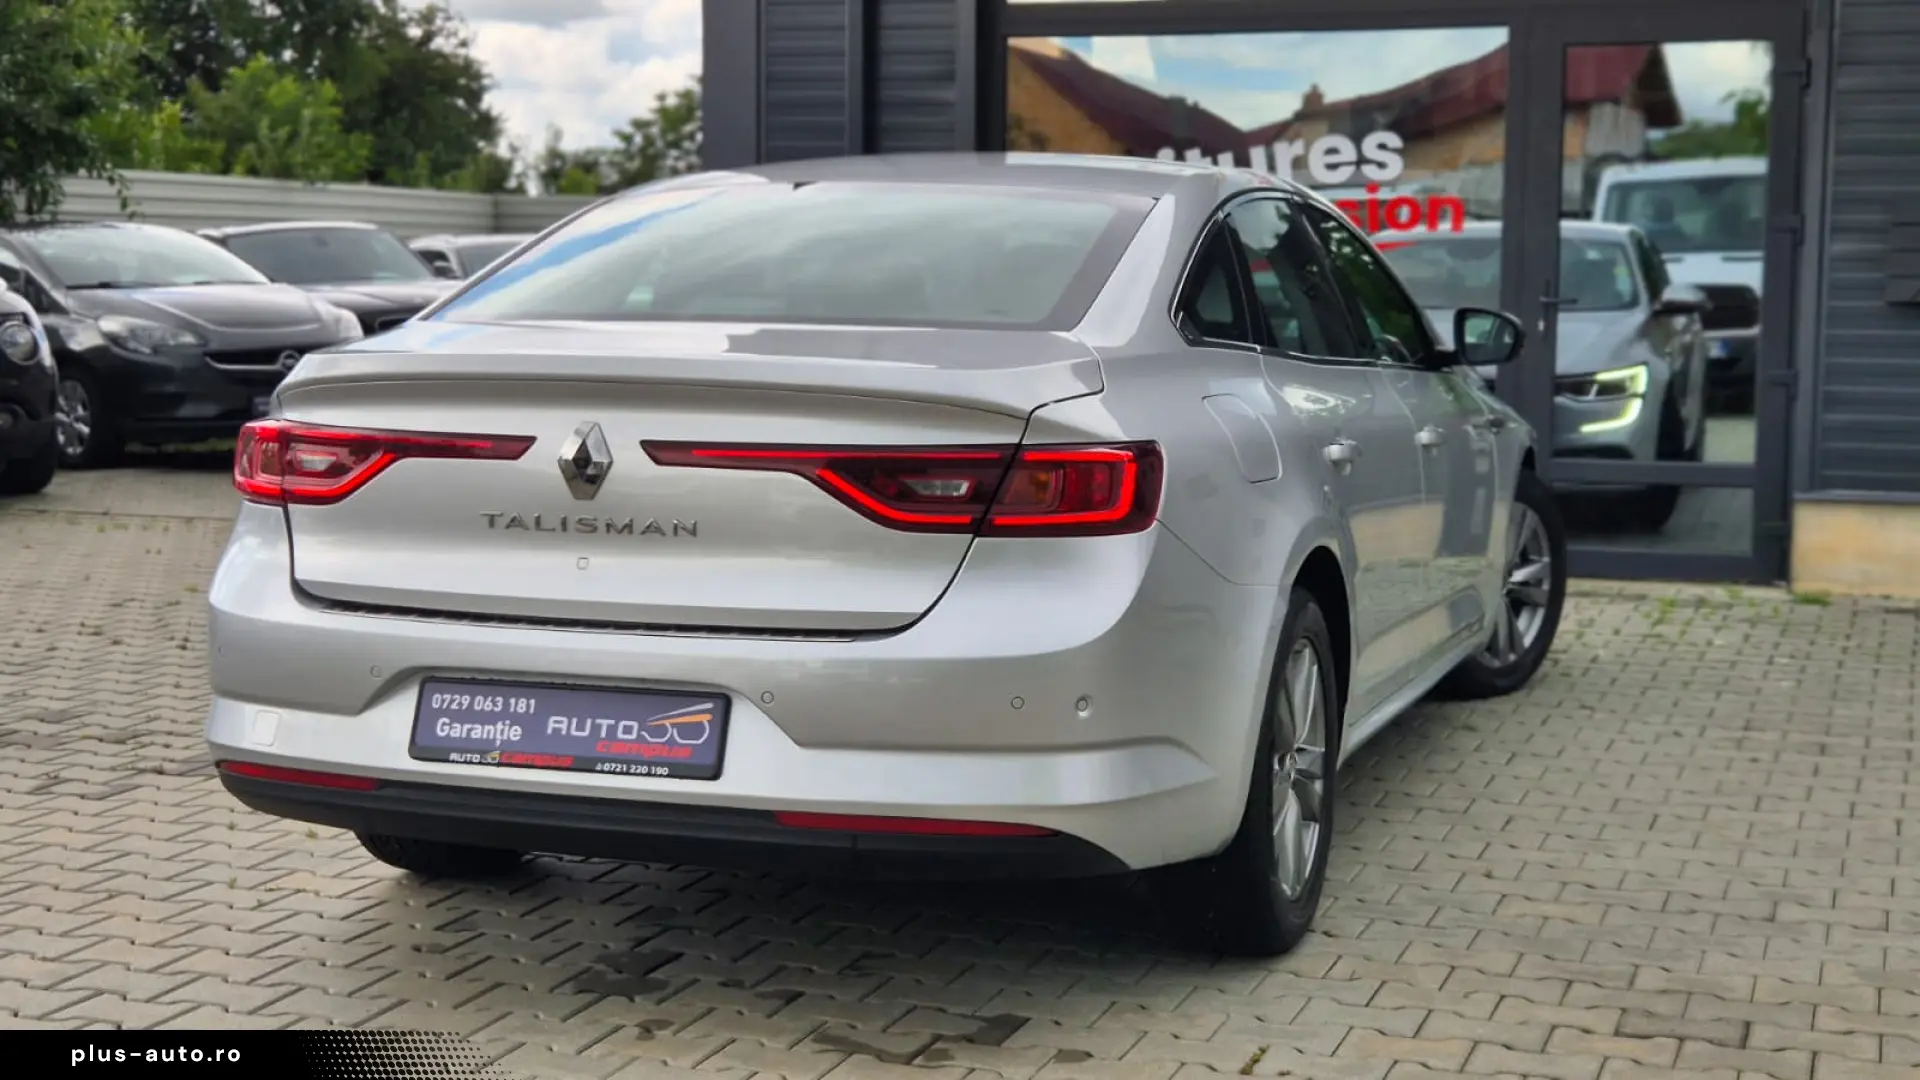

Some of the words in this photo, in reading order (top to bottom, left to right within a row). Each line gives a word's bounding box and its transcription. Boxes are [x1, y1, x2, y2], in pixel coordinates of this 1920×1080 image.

[479, 509, 698, 538] TALISMAN
[431, 692, 471, 710] 0729
[473, 695, 504, 712] 063
[508, 697, 536, 715] 181
[435, 716, 523, 748] Garanție
[547, 715, 640, 740] AUTO
[449, 751, 481, 764] AUTO
[595, 740, 693, 759] campus
[603, 762, 627, 773] 0721
[650, 766, 669, 776] 190
